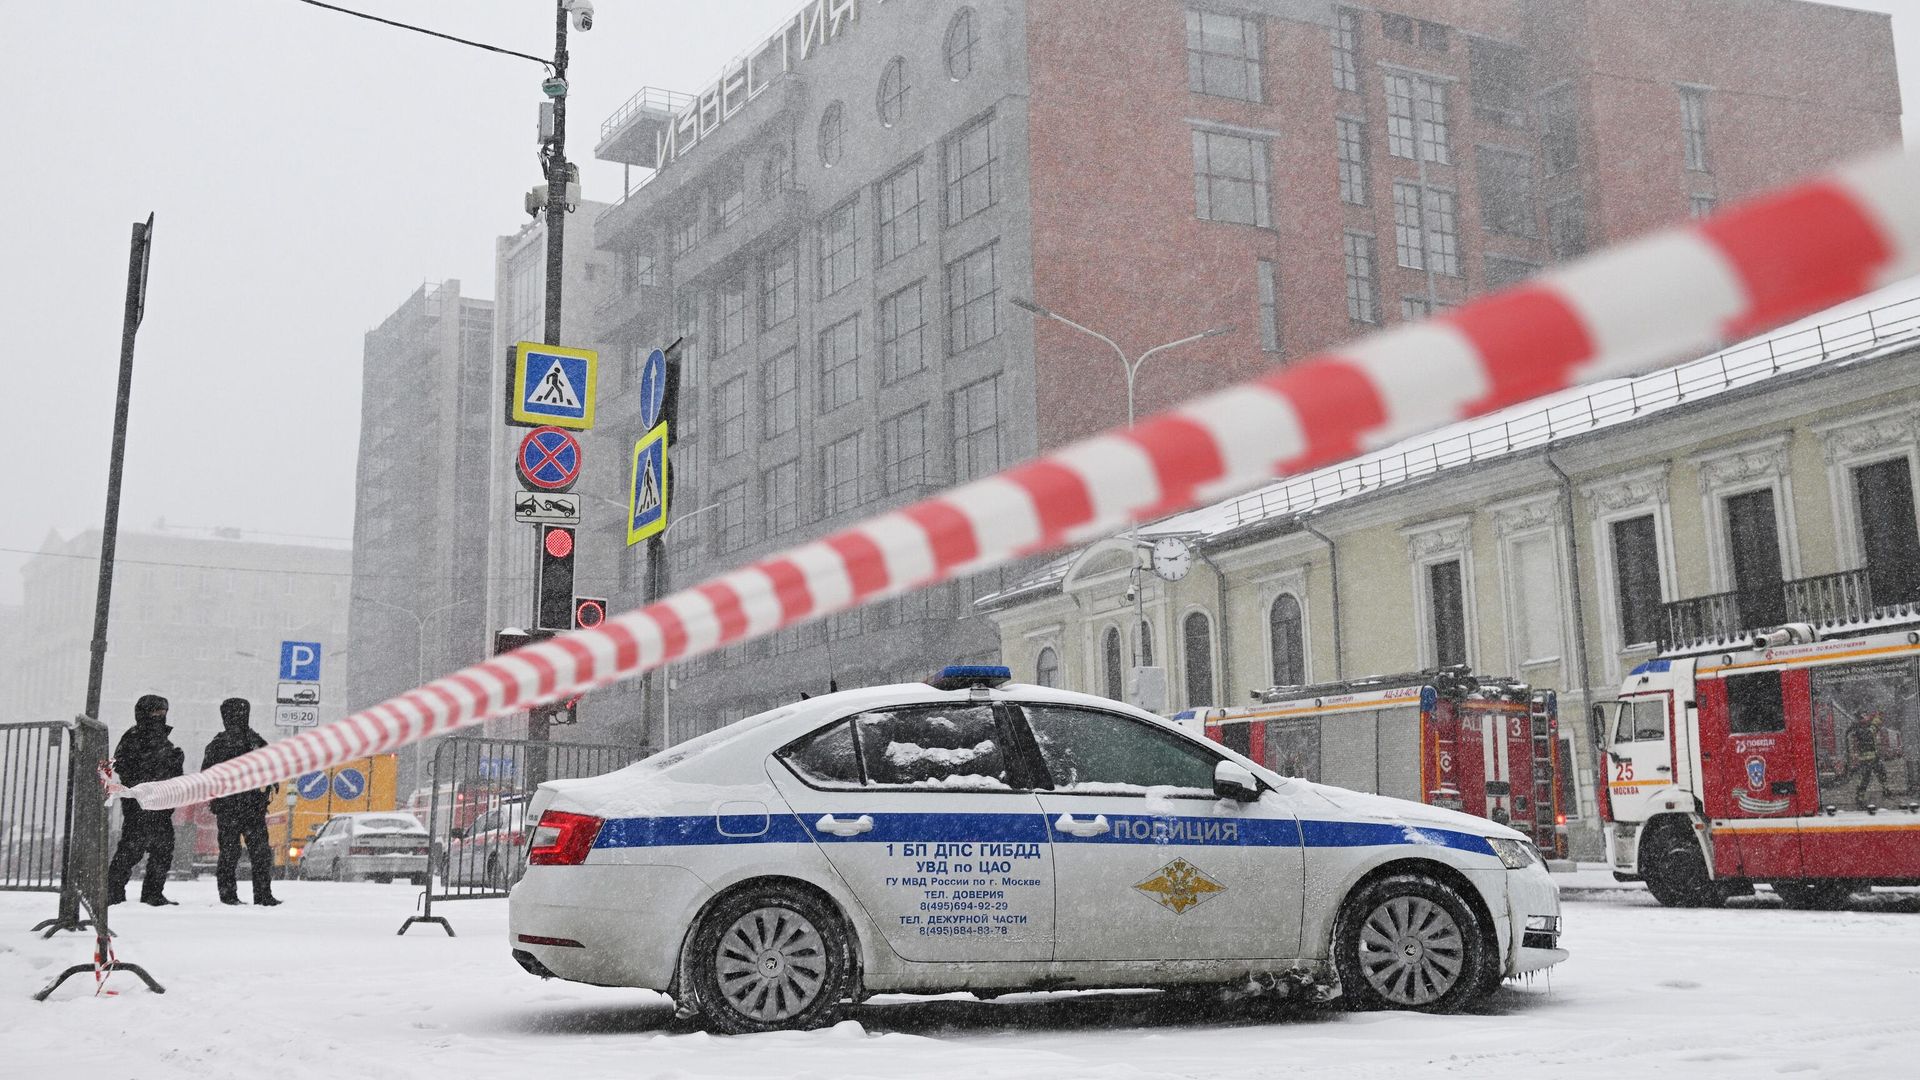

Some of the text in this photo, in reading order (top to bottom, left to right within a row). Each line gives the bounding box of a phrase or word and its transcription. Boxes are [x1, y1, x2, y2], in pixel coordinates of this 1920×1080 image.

[290, 645, 314, 676] P
[301, 711, 314, 721] 20
[1616, 762, 1634, 781] 25
[1613, 786, 1639, 795] МОСКВА
[1114, 820, 1238, 843] ПОЛИЦИЯ
[886, 843, 1041, 860] 1 БП ДПС ГИБДД
[916, 861, 1011, 875] УВД по ЦАО
[886, 877, 898, 886] ГУ
[902, 877, 927, 887] МВД
[931, 877, 969, 886] России
[1002, 877, 1041, 886] Москве
[924, 890, 1004, 900] ТЕЛ. ДОВЕРИЯ
[920, 902, 1008, 912] 8(495)694-92-29
[900, 913, 1027, 925] ТЕЛ. ДЕЖУРНОЙ ЧАСТИ
